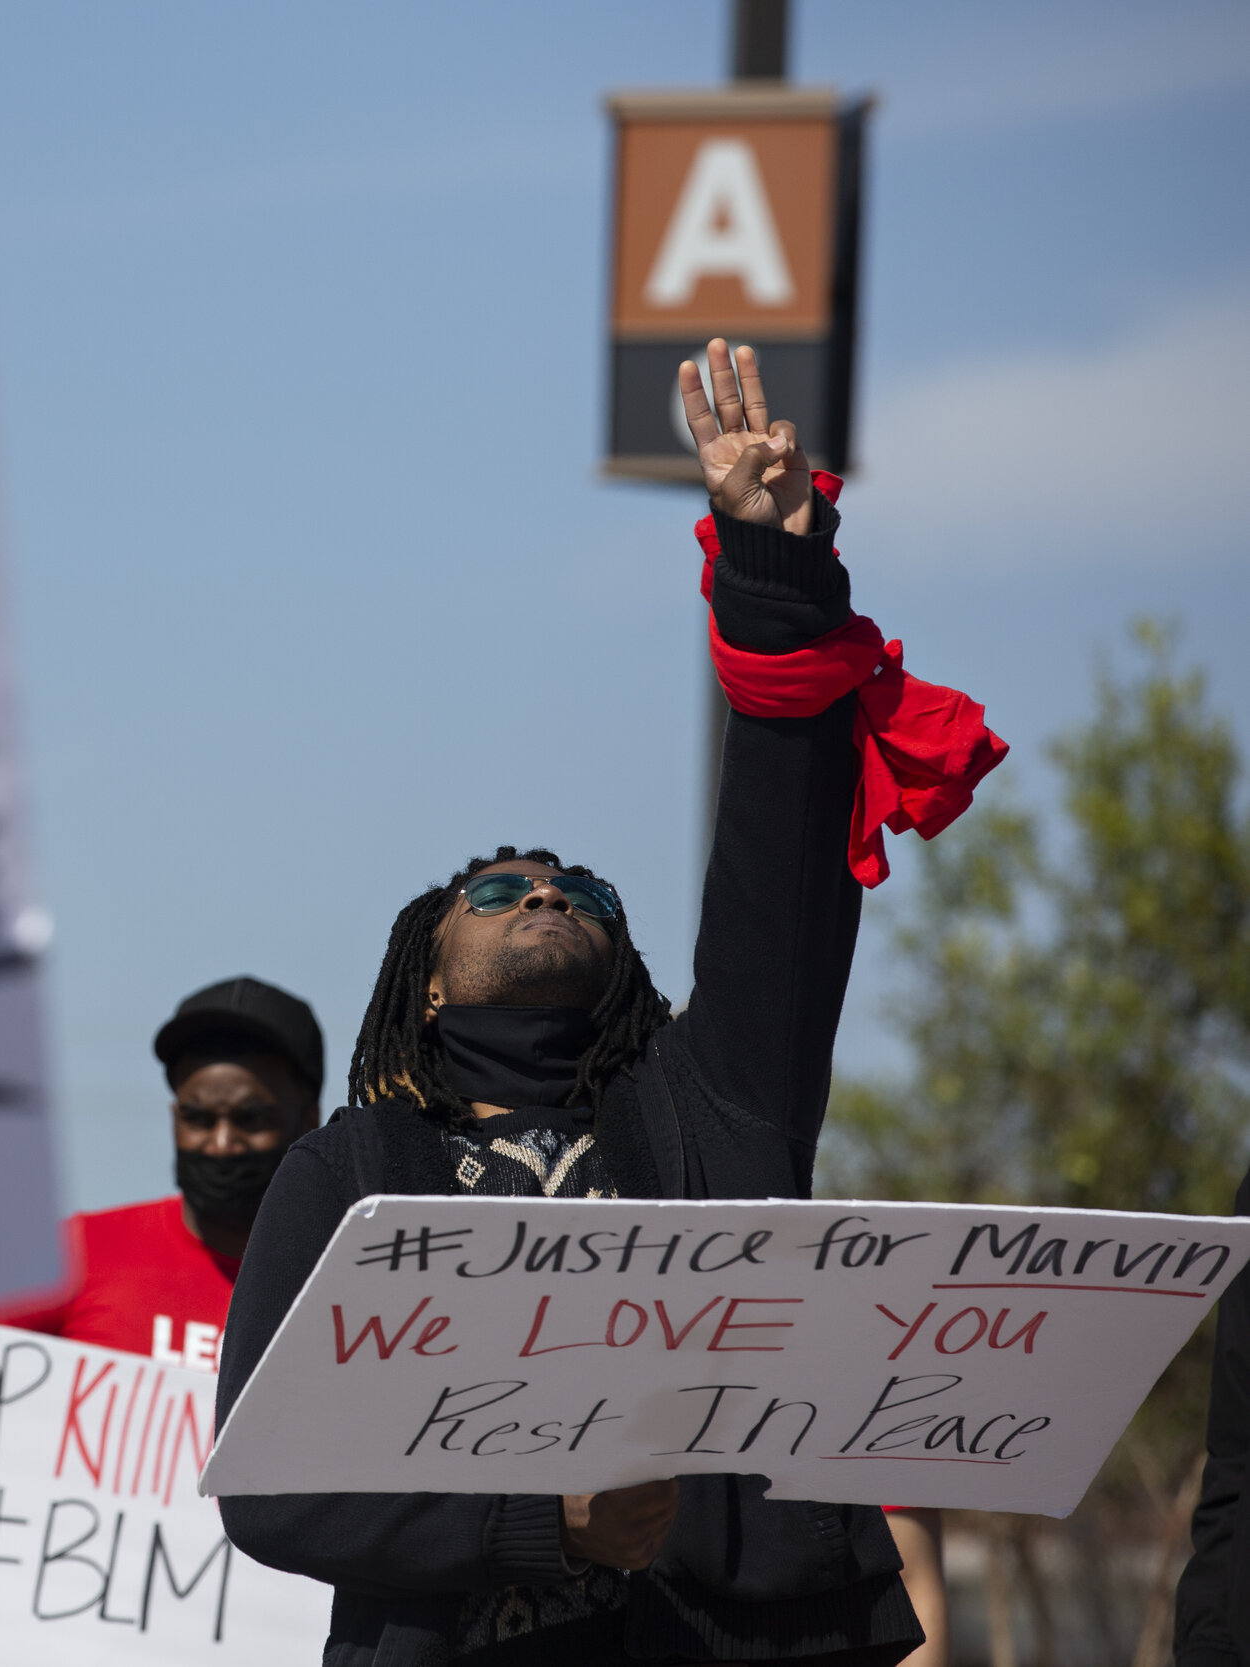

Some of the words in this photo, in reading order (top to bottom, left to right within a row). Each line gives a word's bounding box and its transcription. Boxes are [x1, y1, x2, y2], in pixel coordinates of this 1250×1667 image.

[646, 138, 796, 308] A
[355, 1221, 773, 1278] #Justice
[797, 1216, 930, 1270] for
[949, 1223, 1230, 1286] Marvin
[152, 1314, 221, 1374] LE
[331, 1296, 458, 1364] We
[518, 1295, 804, 1357] LOVE
[404, 1380, 624, 1456] Rest
[650, 1385, 817, 1456] In
[839, 1374, 1051, 1461] Peace
